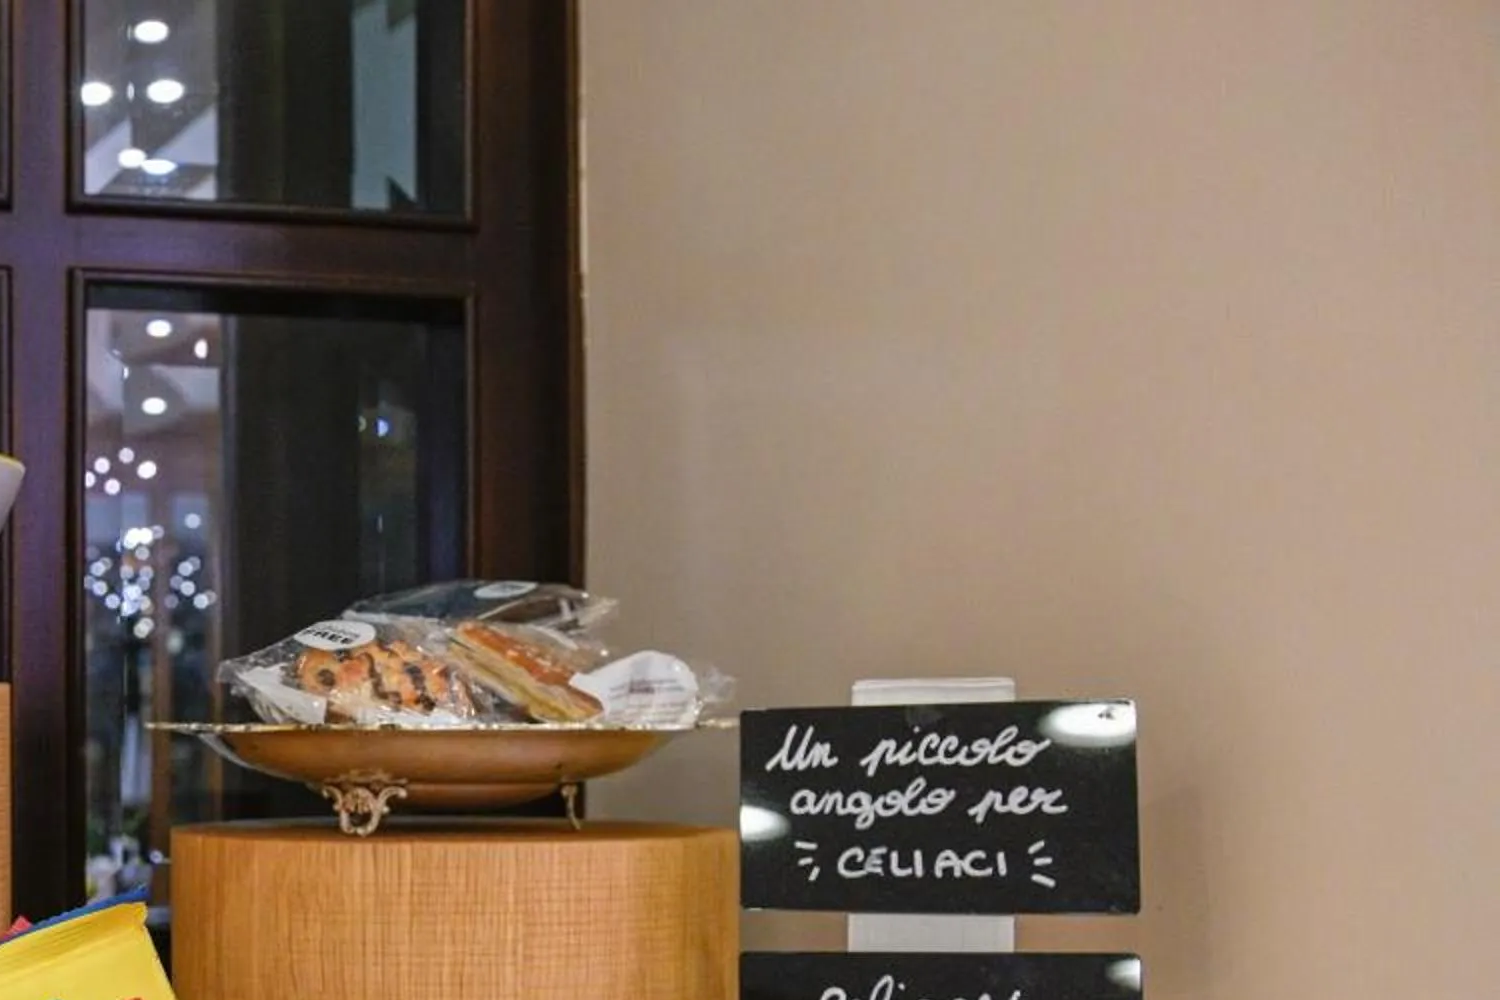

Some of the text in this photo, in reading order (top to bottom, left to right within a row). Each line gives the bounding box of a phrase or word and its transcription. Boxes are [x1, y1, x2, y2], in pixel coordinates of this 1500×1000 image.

[766, 724, 1051, 774] Un piccolo
[790, 777, 1068, 829] angolo per
[837, 846, 1007, 879] CELIACI
